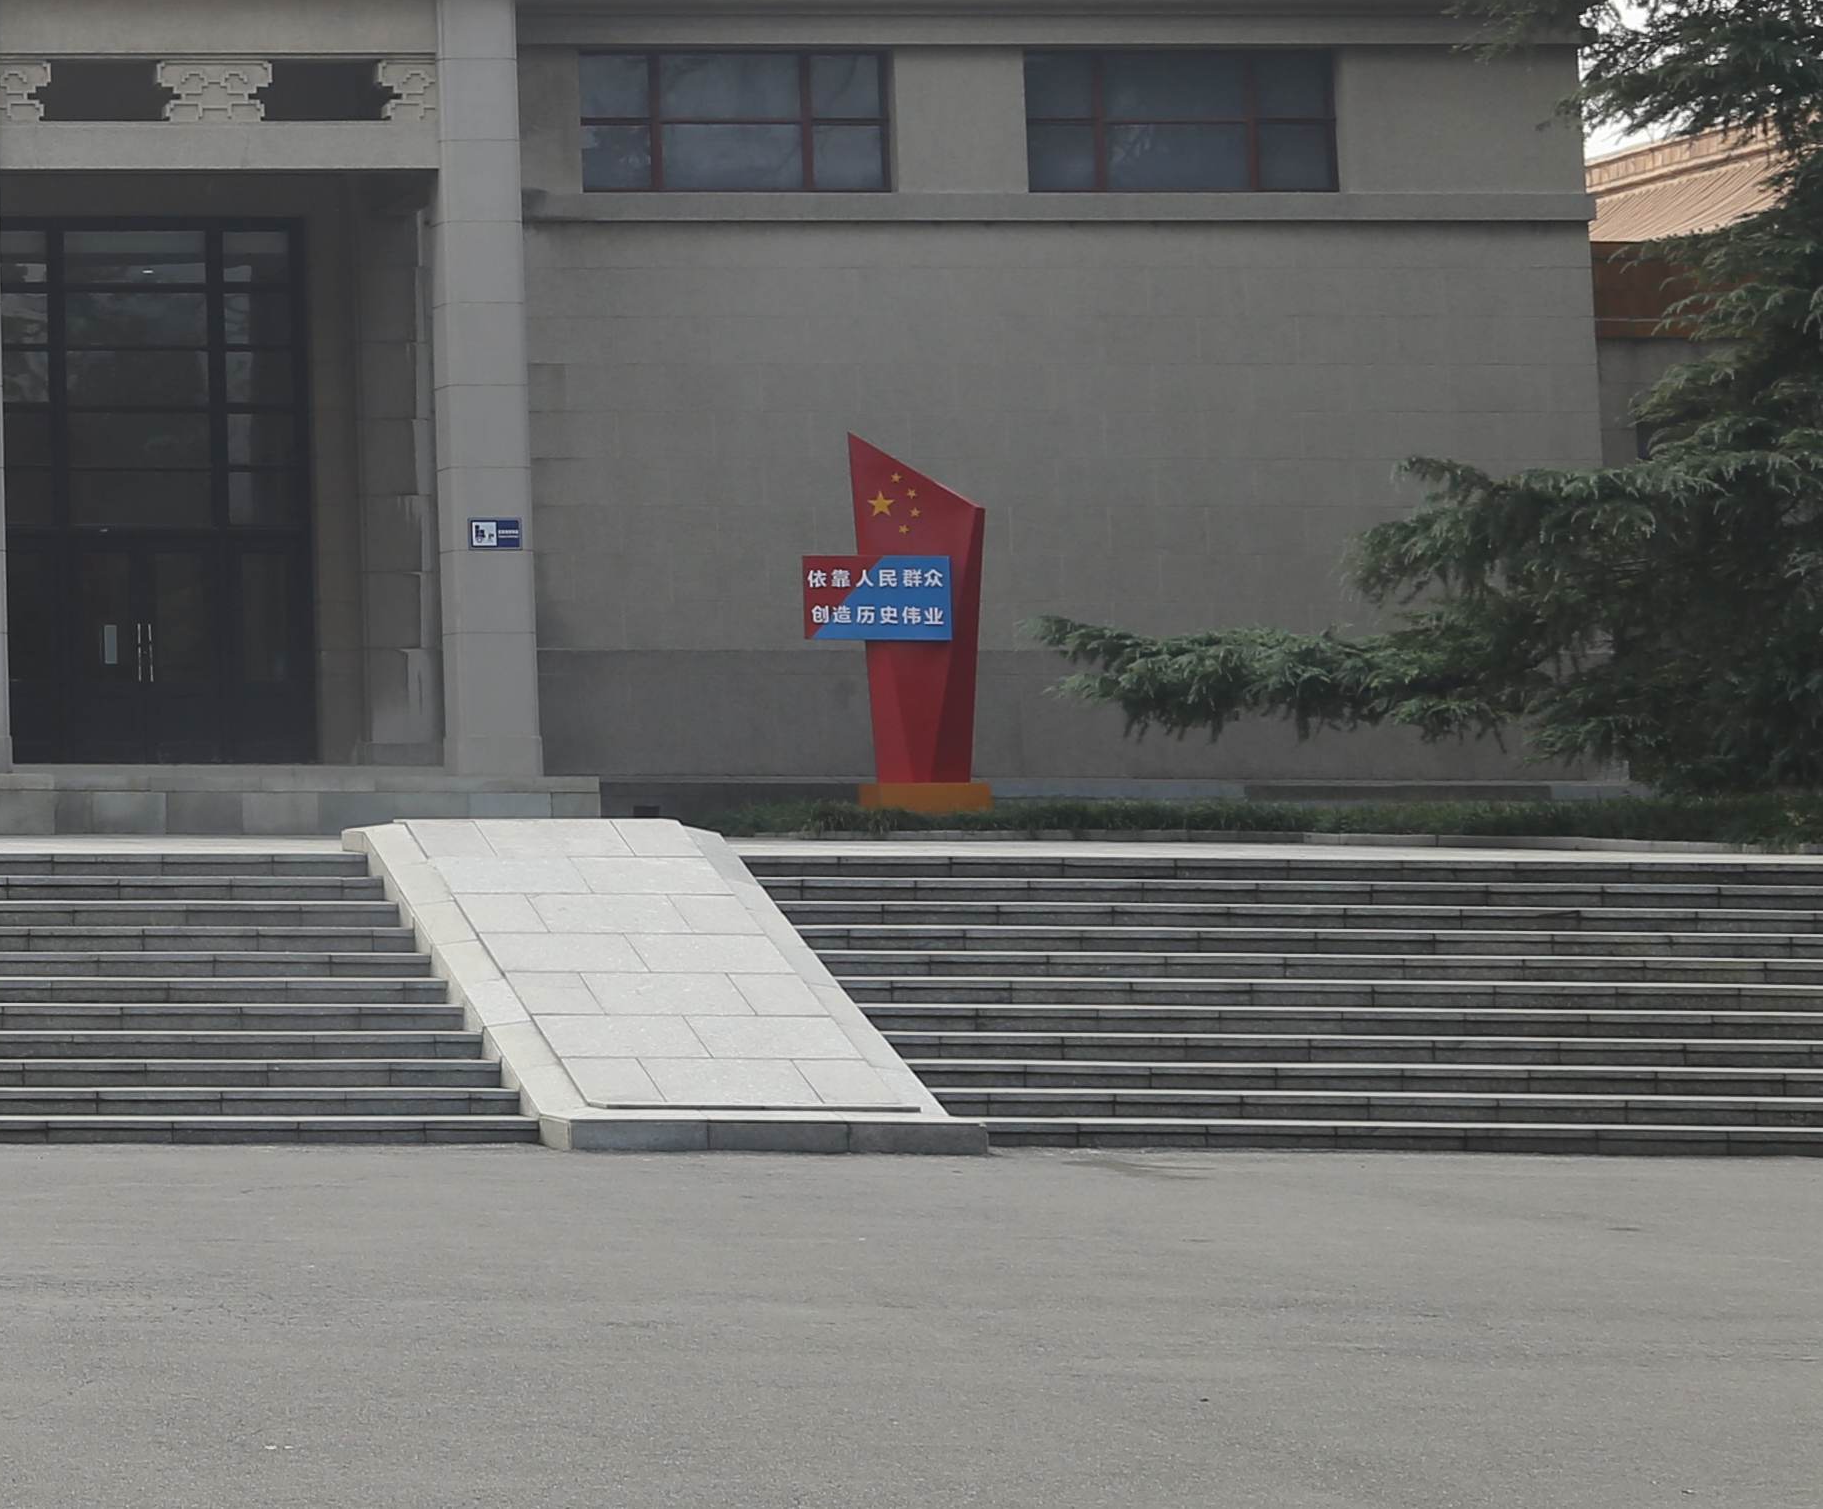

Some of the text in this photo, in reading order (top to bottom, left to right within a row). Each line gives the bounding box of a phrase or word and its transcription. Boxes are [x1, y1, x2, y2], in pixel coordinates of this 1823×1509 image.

[806, 568, 944, 589] 依靠人民群众
[810, 604, 945, 626] 创造历史伟业
